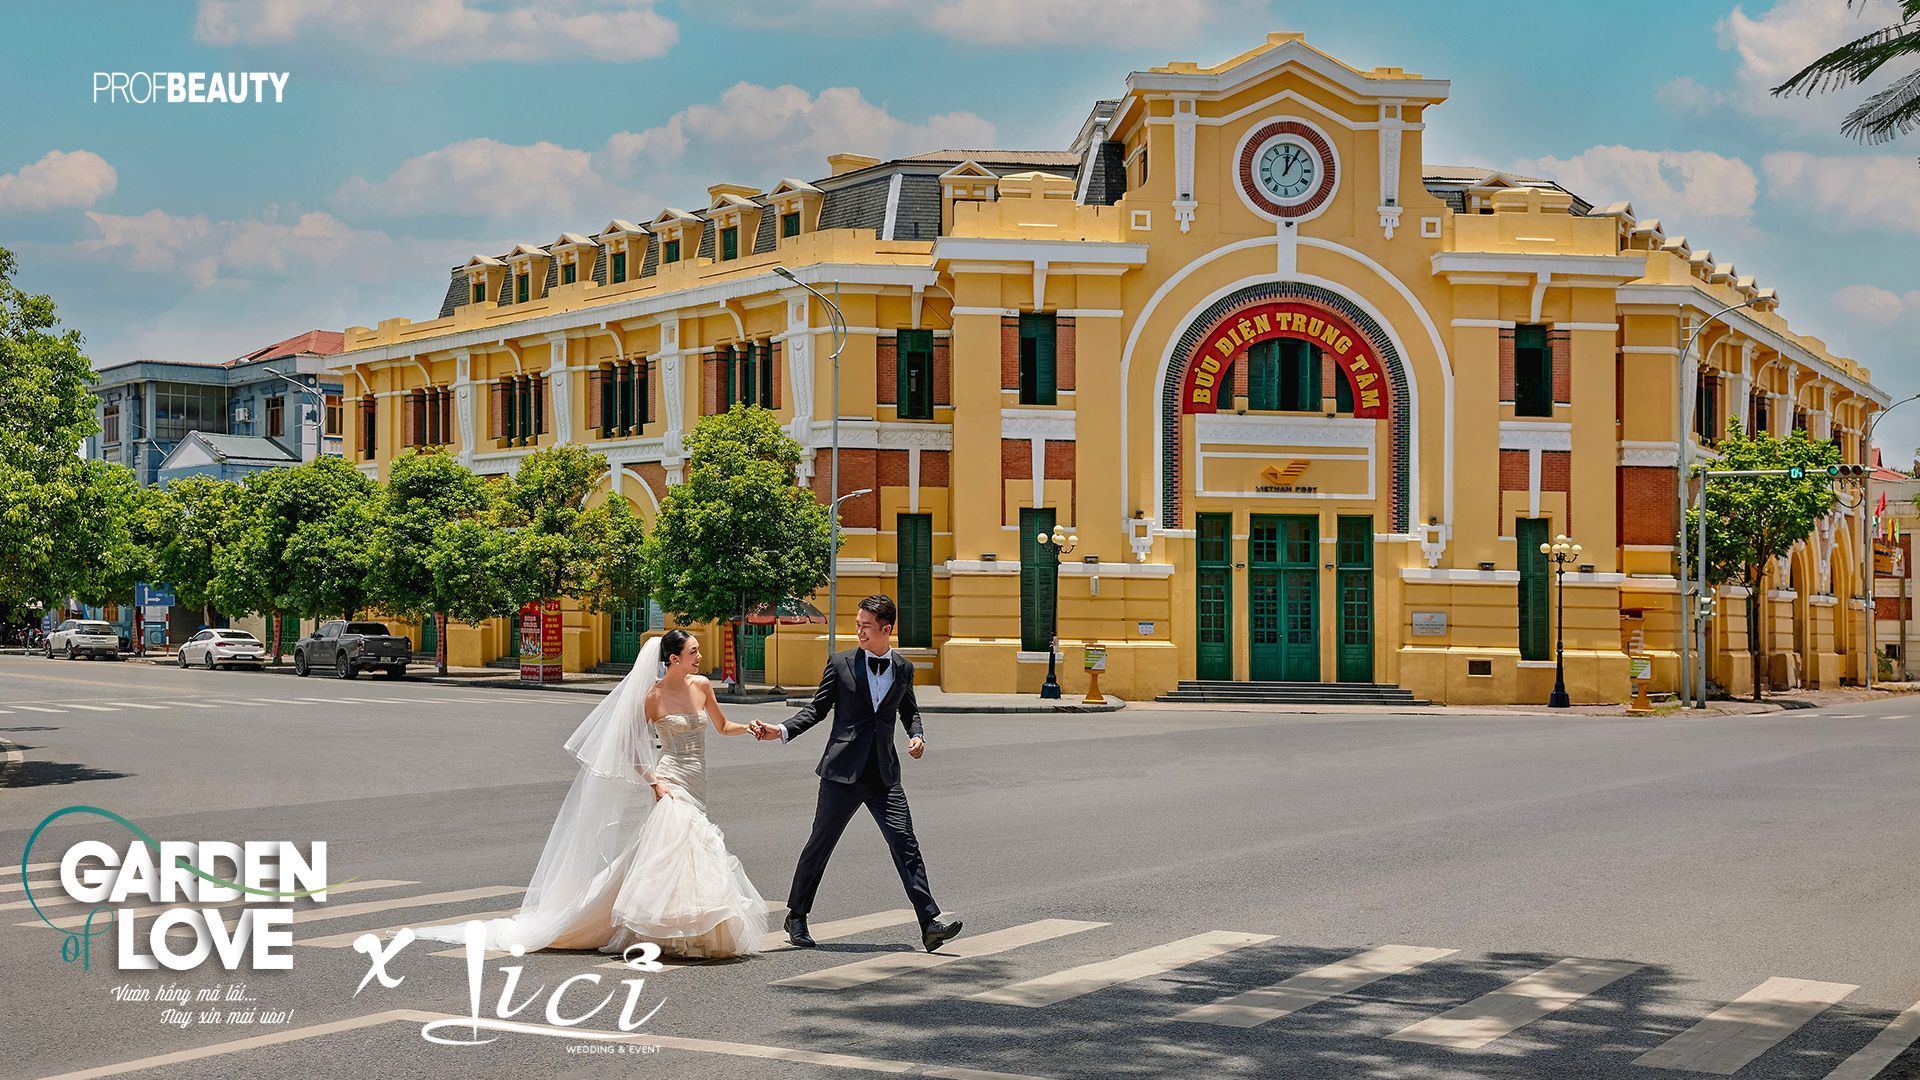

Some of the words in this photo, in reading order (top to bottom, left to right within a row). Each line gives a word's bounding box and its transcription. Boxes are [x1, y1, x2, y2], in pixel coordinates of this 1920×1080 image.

[1193, 355, 1221, 404] BƯU
[1276, 312, 1353, 355] TRUNG
[1349, 354, 1381, 409] TÂM
